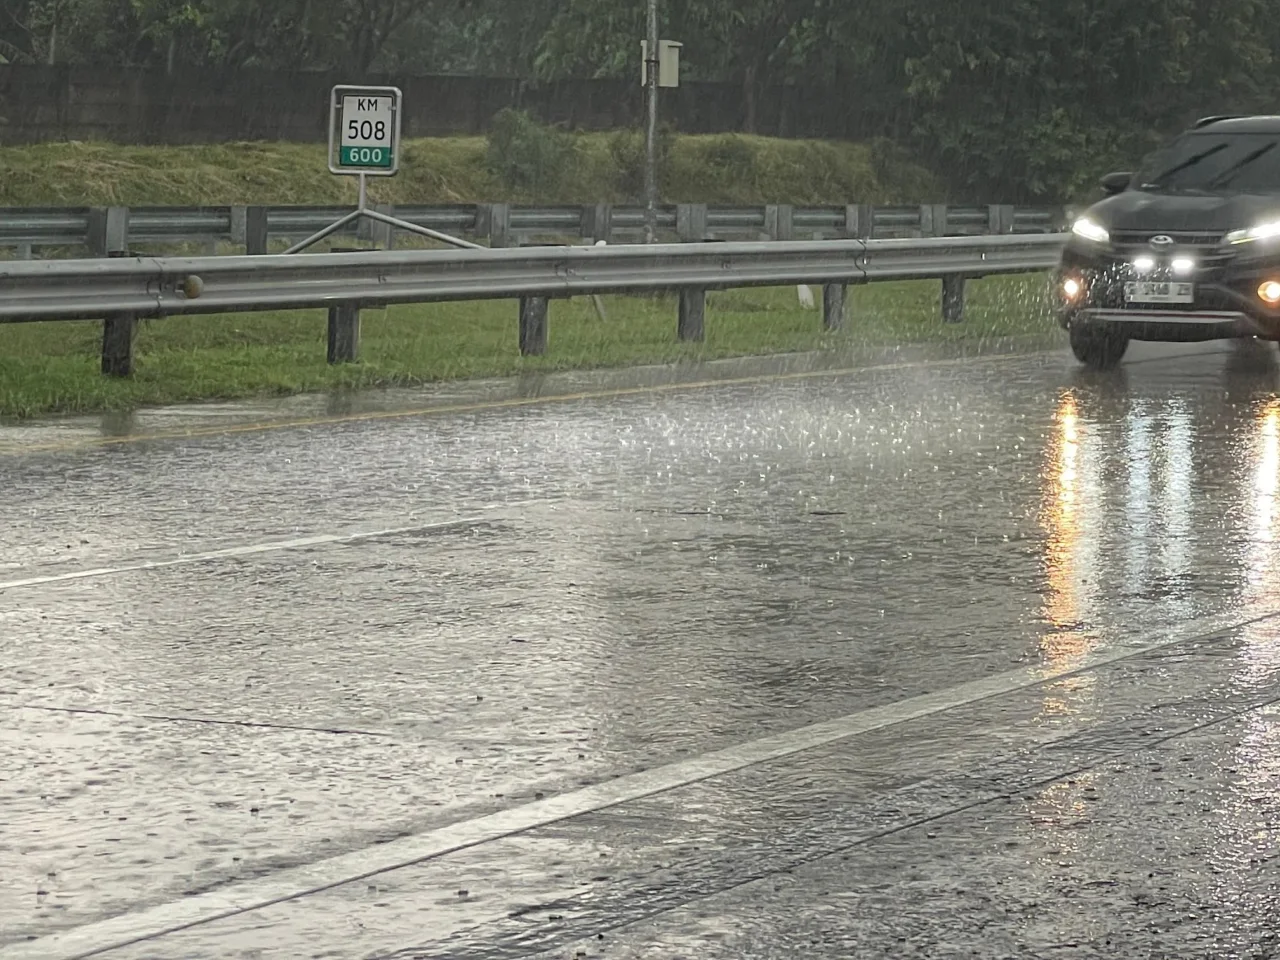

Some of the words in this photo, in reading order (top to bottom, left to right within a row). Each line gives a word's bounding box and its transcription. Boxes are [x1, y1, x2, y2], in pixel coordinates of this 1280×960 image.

[357, 98, 378, 112] KM
[347, 119, 385, 141] 508
[349, 148, 382, 163] 600
